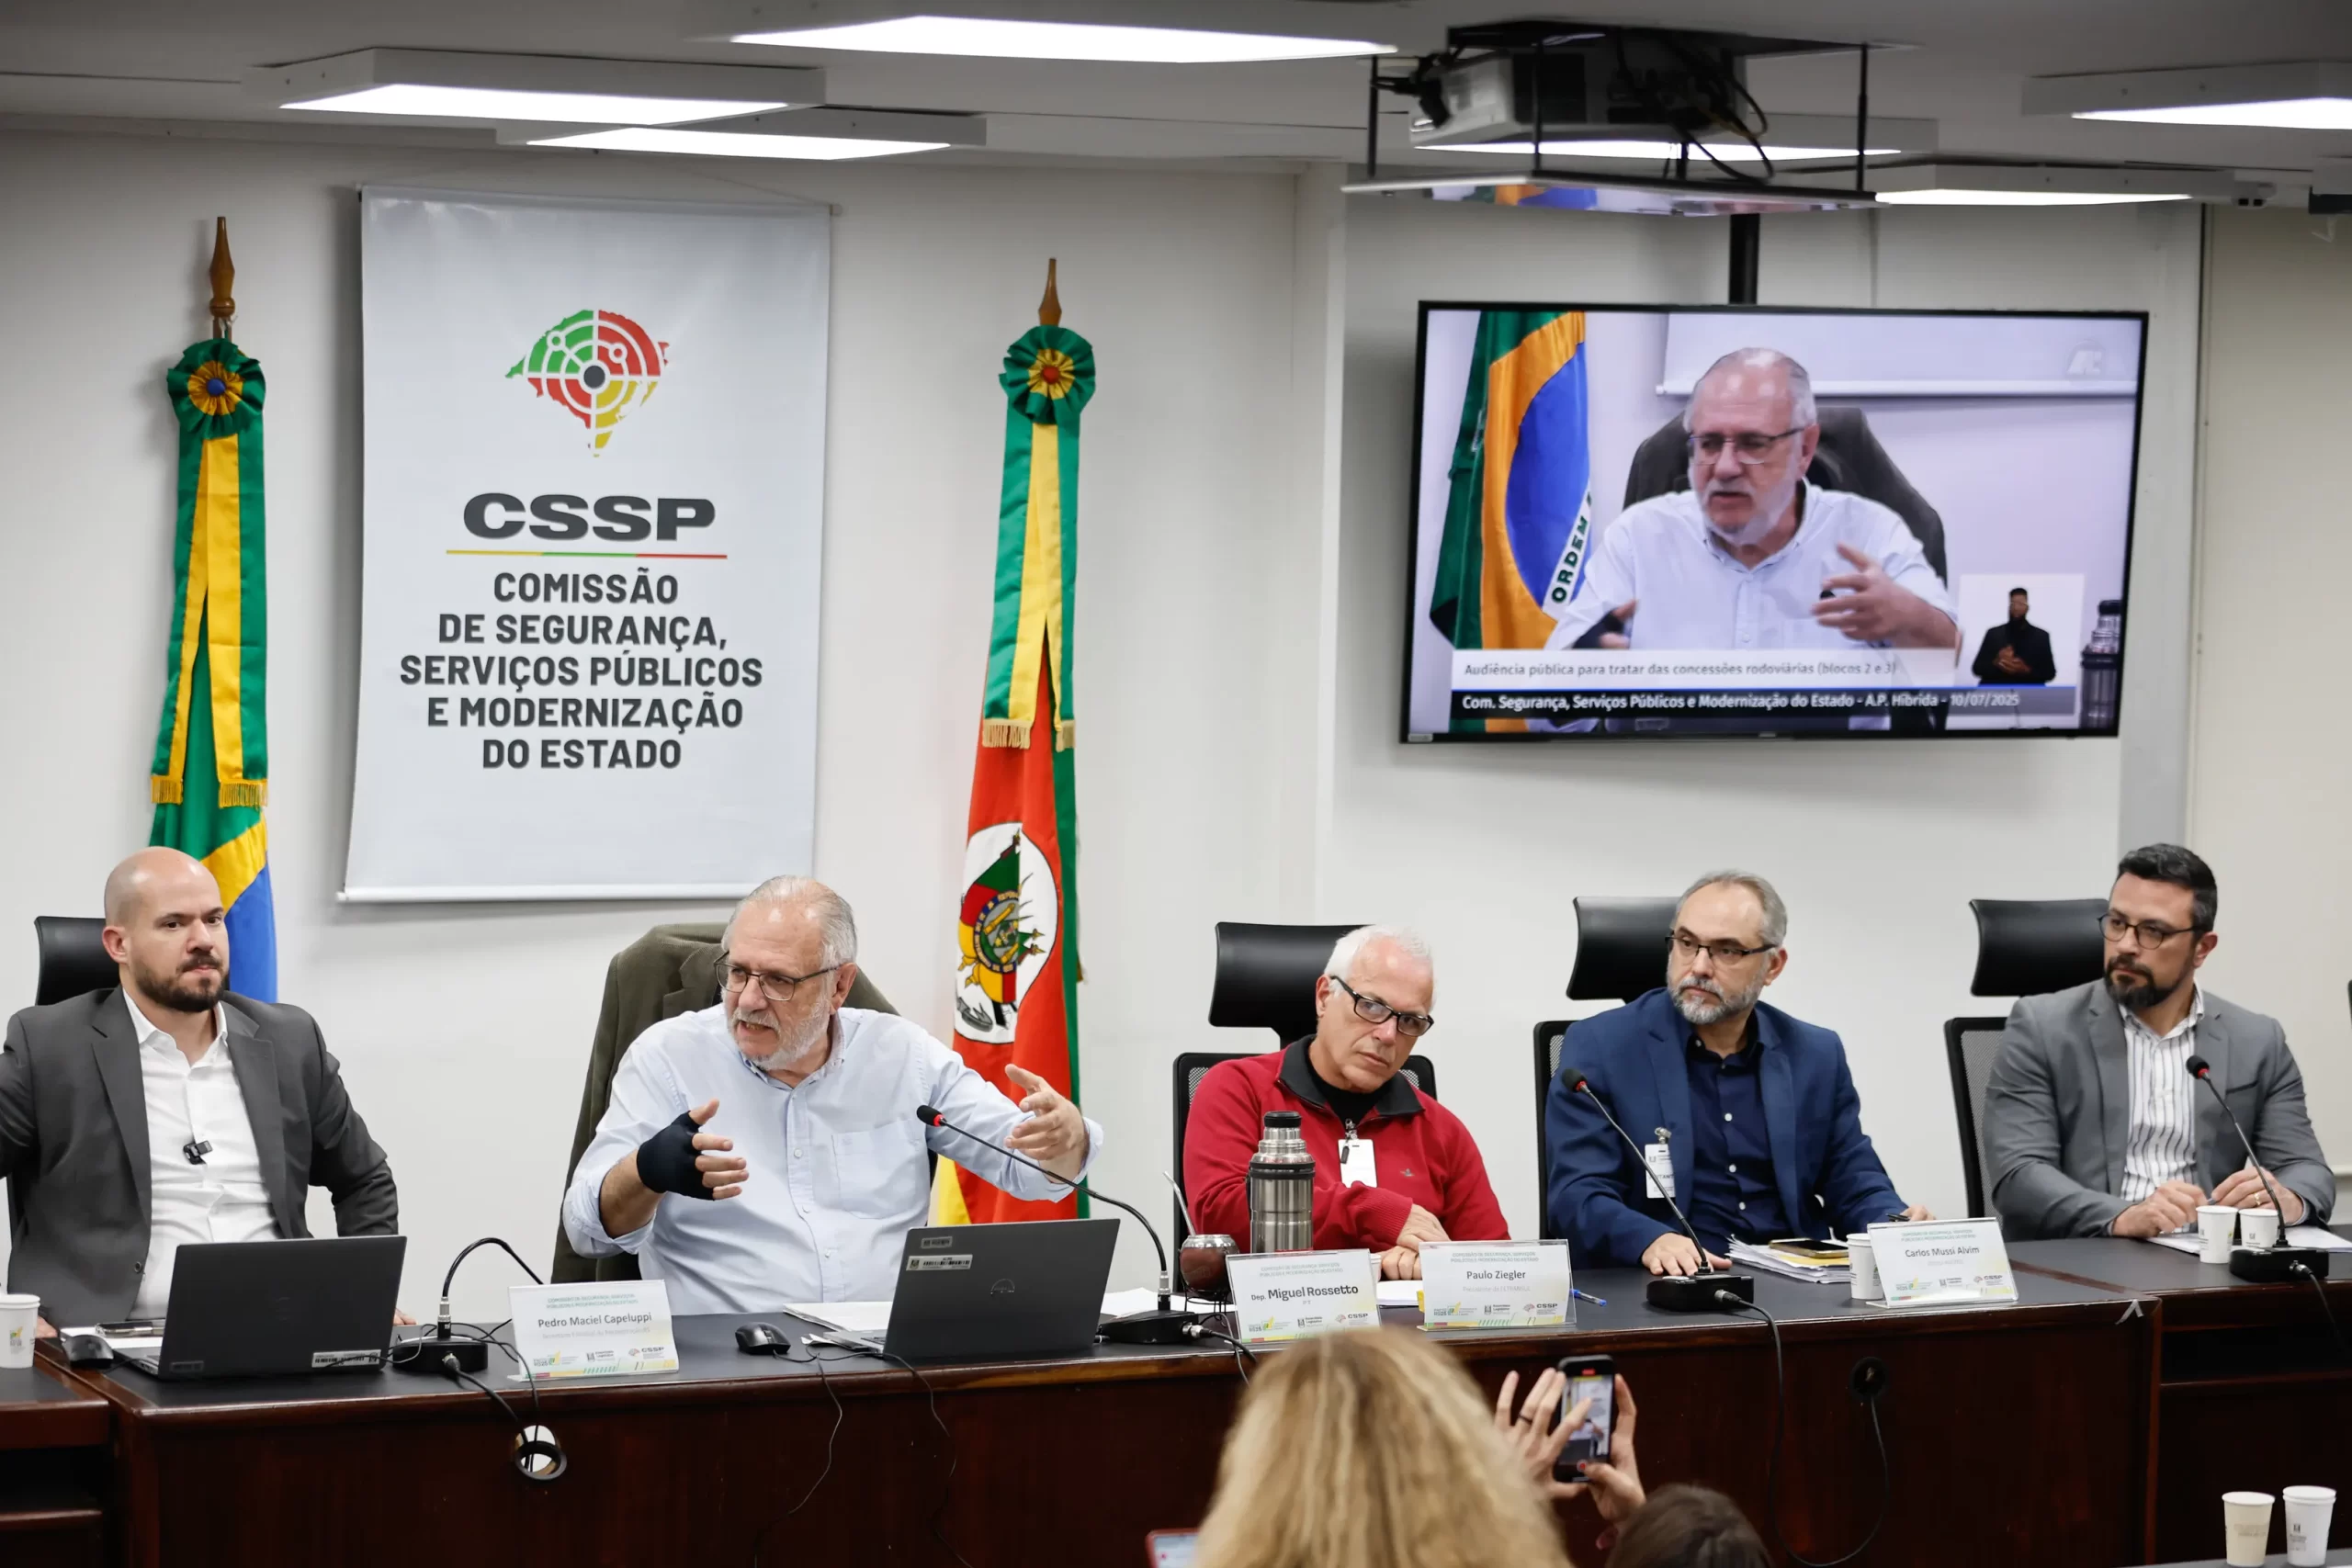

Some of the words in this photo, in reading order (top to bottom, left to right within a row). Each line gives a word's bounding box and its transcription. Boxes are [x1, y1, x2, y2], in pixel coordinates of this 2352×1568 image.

[463, 492, 715, 541] CSSP
[493, 567, 678, 604] COMISSÃO
[439, 614, 484, 644] DE
[495, 615, 727, 652] SEGURANÇA,
[400, 655, 579, 693] SERVIÇOS
[590, 649, 763, 688] PÚBLICOS
[1464, 662, 1525, 676] Audiência
[1529, 662, 1574, 677] pública
[1577, 666, 1605, 677] para
[1609, 663, 1645, 675] tratar
[1648, 662, 1669, 675] das
[1672, 662, 1743, 675] concessões
[1746, 661, 1815, 675] rodoviárias
[1817, 661, 1861, 677] (blocos
[1864, 663, 1871, 674] 2
[1873, 665, 1882, 674] e
[1883, 661, 1897, 677] 3)
[428, 697, 449, 727] E
[460, 692, 743, 735] MODERNIZAÇÃO
[1462, 696, 1496, 710] Com.
[1498, 696, 1570, 713] Segurança,
[1573, 694, 1627, 712] Serviços
[1630, 694, 1686, 709] Públicos
[1688, 699, 1695, 709] e
[1698, 694, 1788, 712] Modernização
[1791, 694, 1809, 708] do
[1811, 694, 1854, 708] Estado
[1864, 694, 1889, 708] A.P.
[1950, 693, 2020, 708] 10/07/2025
[482, 739, 530, 769] DO
[541, 739, 682, 770] ESTADO
[1905, 1248, 1930, 1258] Carlos
[1932, 1247, 1955, 1257] Mussi
[1958, 1246, 1980, 1255] Alvim
[1466, 1270, 1493, 1280] Paulo
[1495, 1269, 1526, 1280] Ziegler
[1250, 1293, 1266, 1303] Dep.
[1268, 1286, 1306, 1302] Miguel
[1307, 1284, 1359, 1297] Rossetto
[537, 1317, 568, 1329] Pedro
[570, 1314, 602, 1326] Maciel
[605, 1312, 652, 1325] Capeluppi
